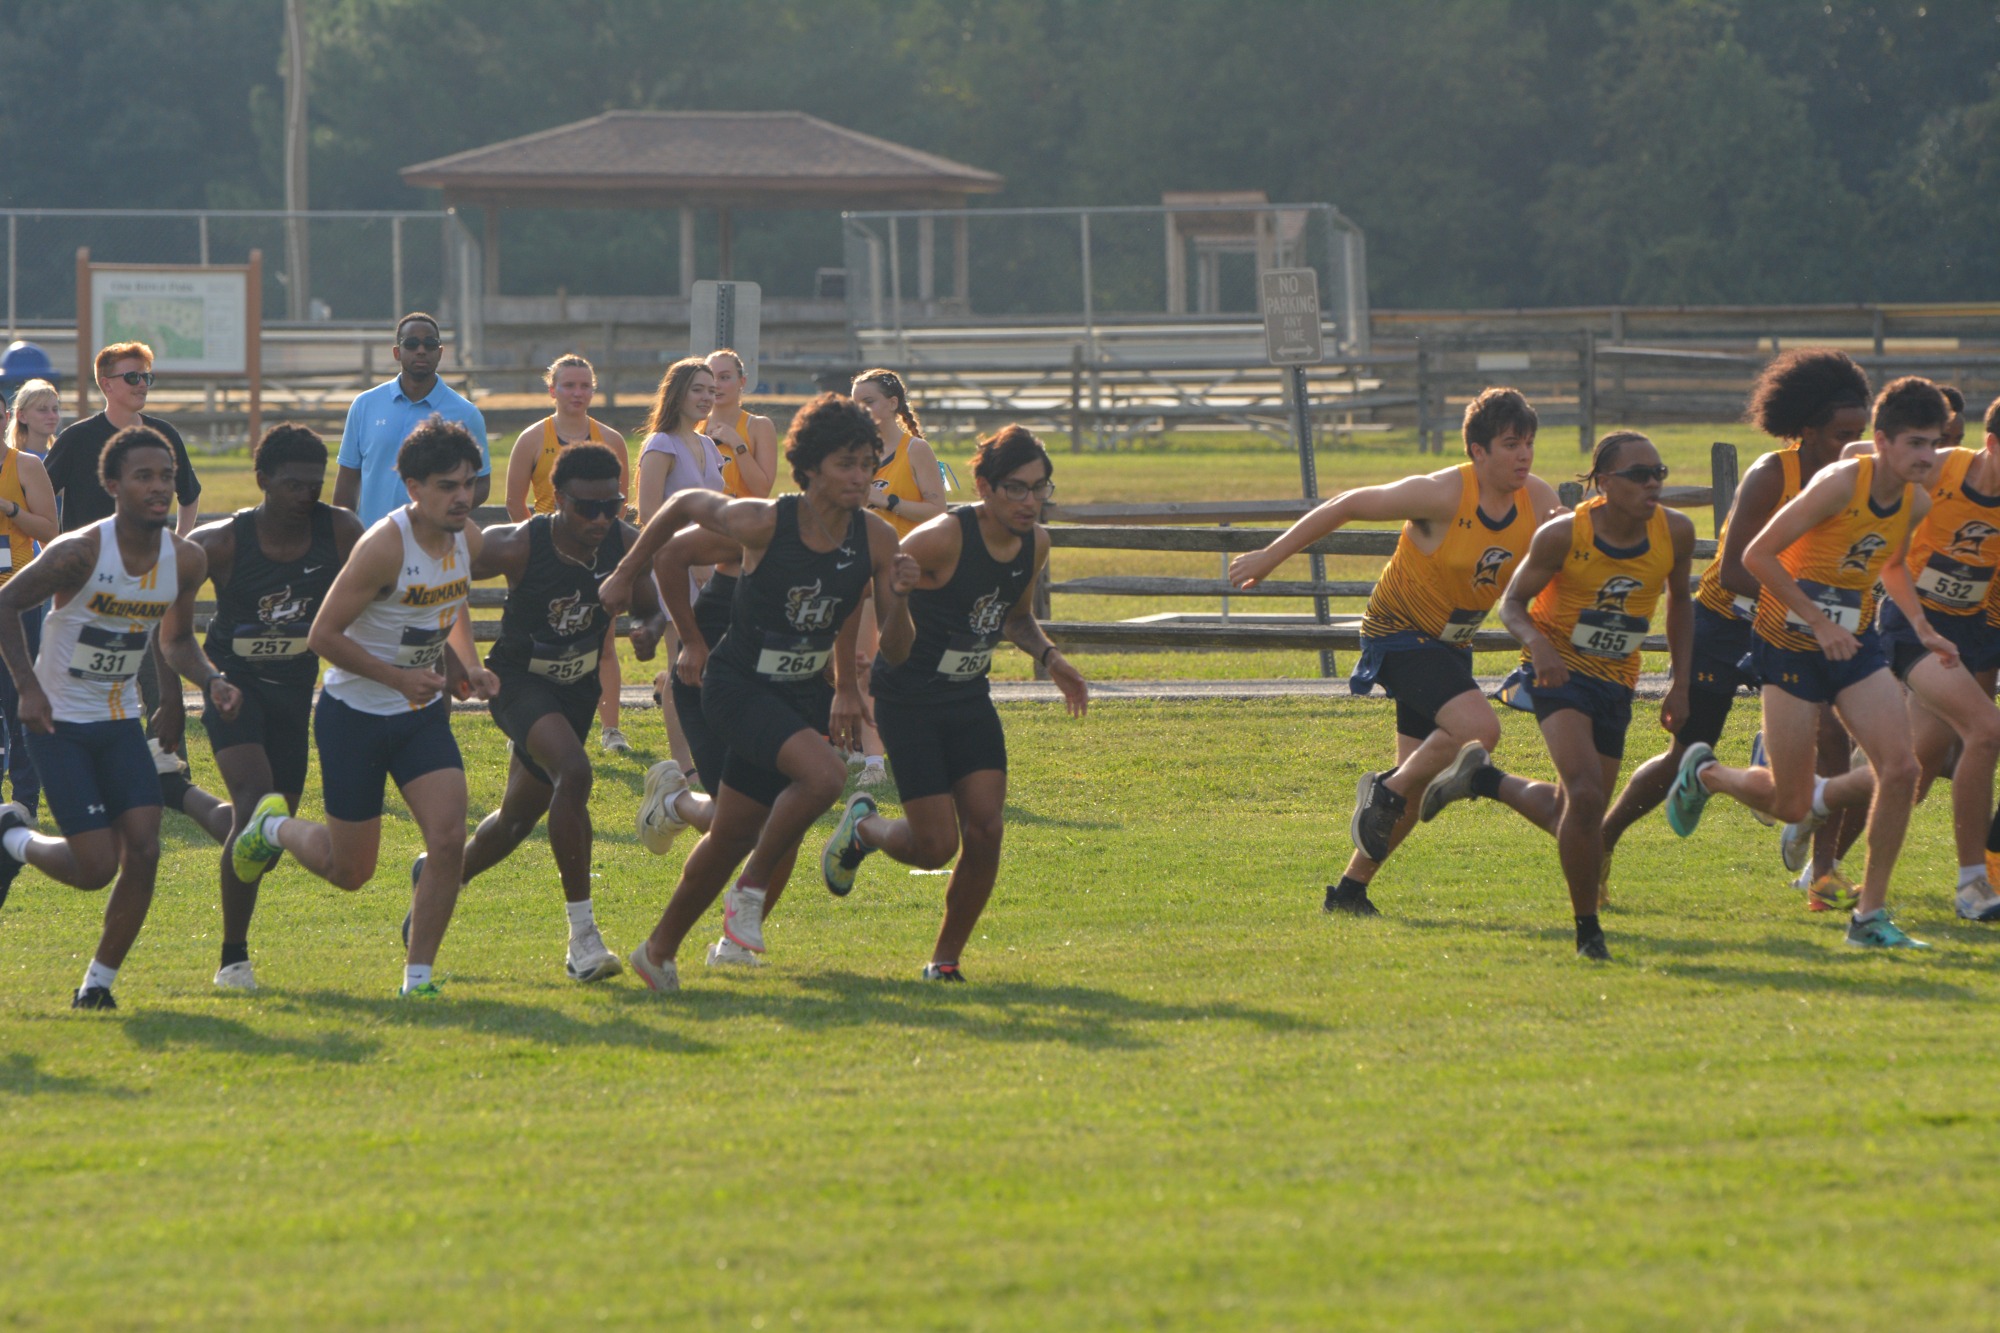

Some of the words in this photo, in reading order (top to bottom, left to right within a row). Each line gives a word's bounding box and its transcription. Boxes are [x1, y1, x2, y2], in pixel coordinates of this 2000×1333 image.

[1279, 275, 1299, 294] NO
[1267, 295, 1316, 314] PARKING
[1283, 315, 1302, 328] ANY
[1283, 329, 1306, 343] TIME
[1935, 577, 1973, 599] 532
[251, 641, 292, 654] 257
[1588, 631, 1628, 651] 455
[90, 652, 126, 672] 331
[410, 646, 442, 665] 325
[776, 655, 816, 673] 264
[547, 660, 584, 678] 252
